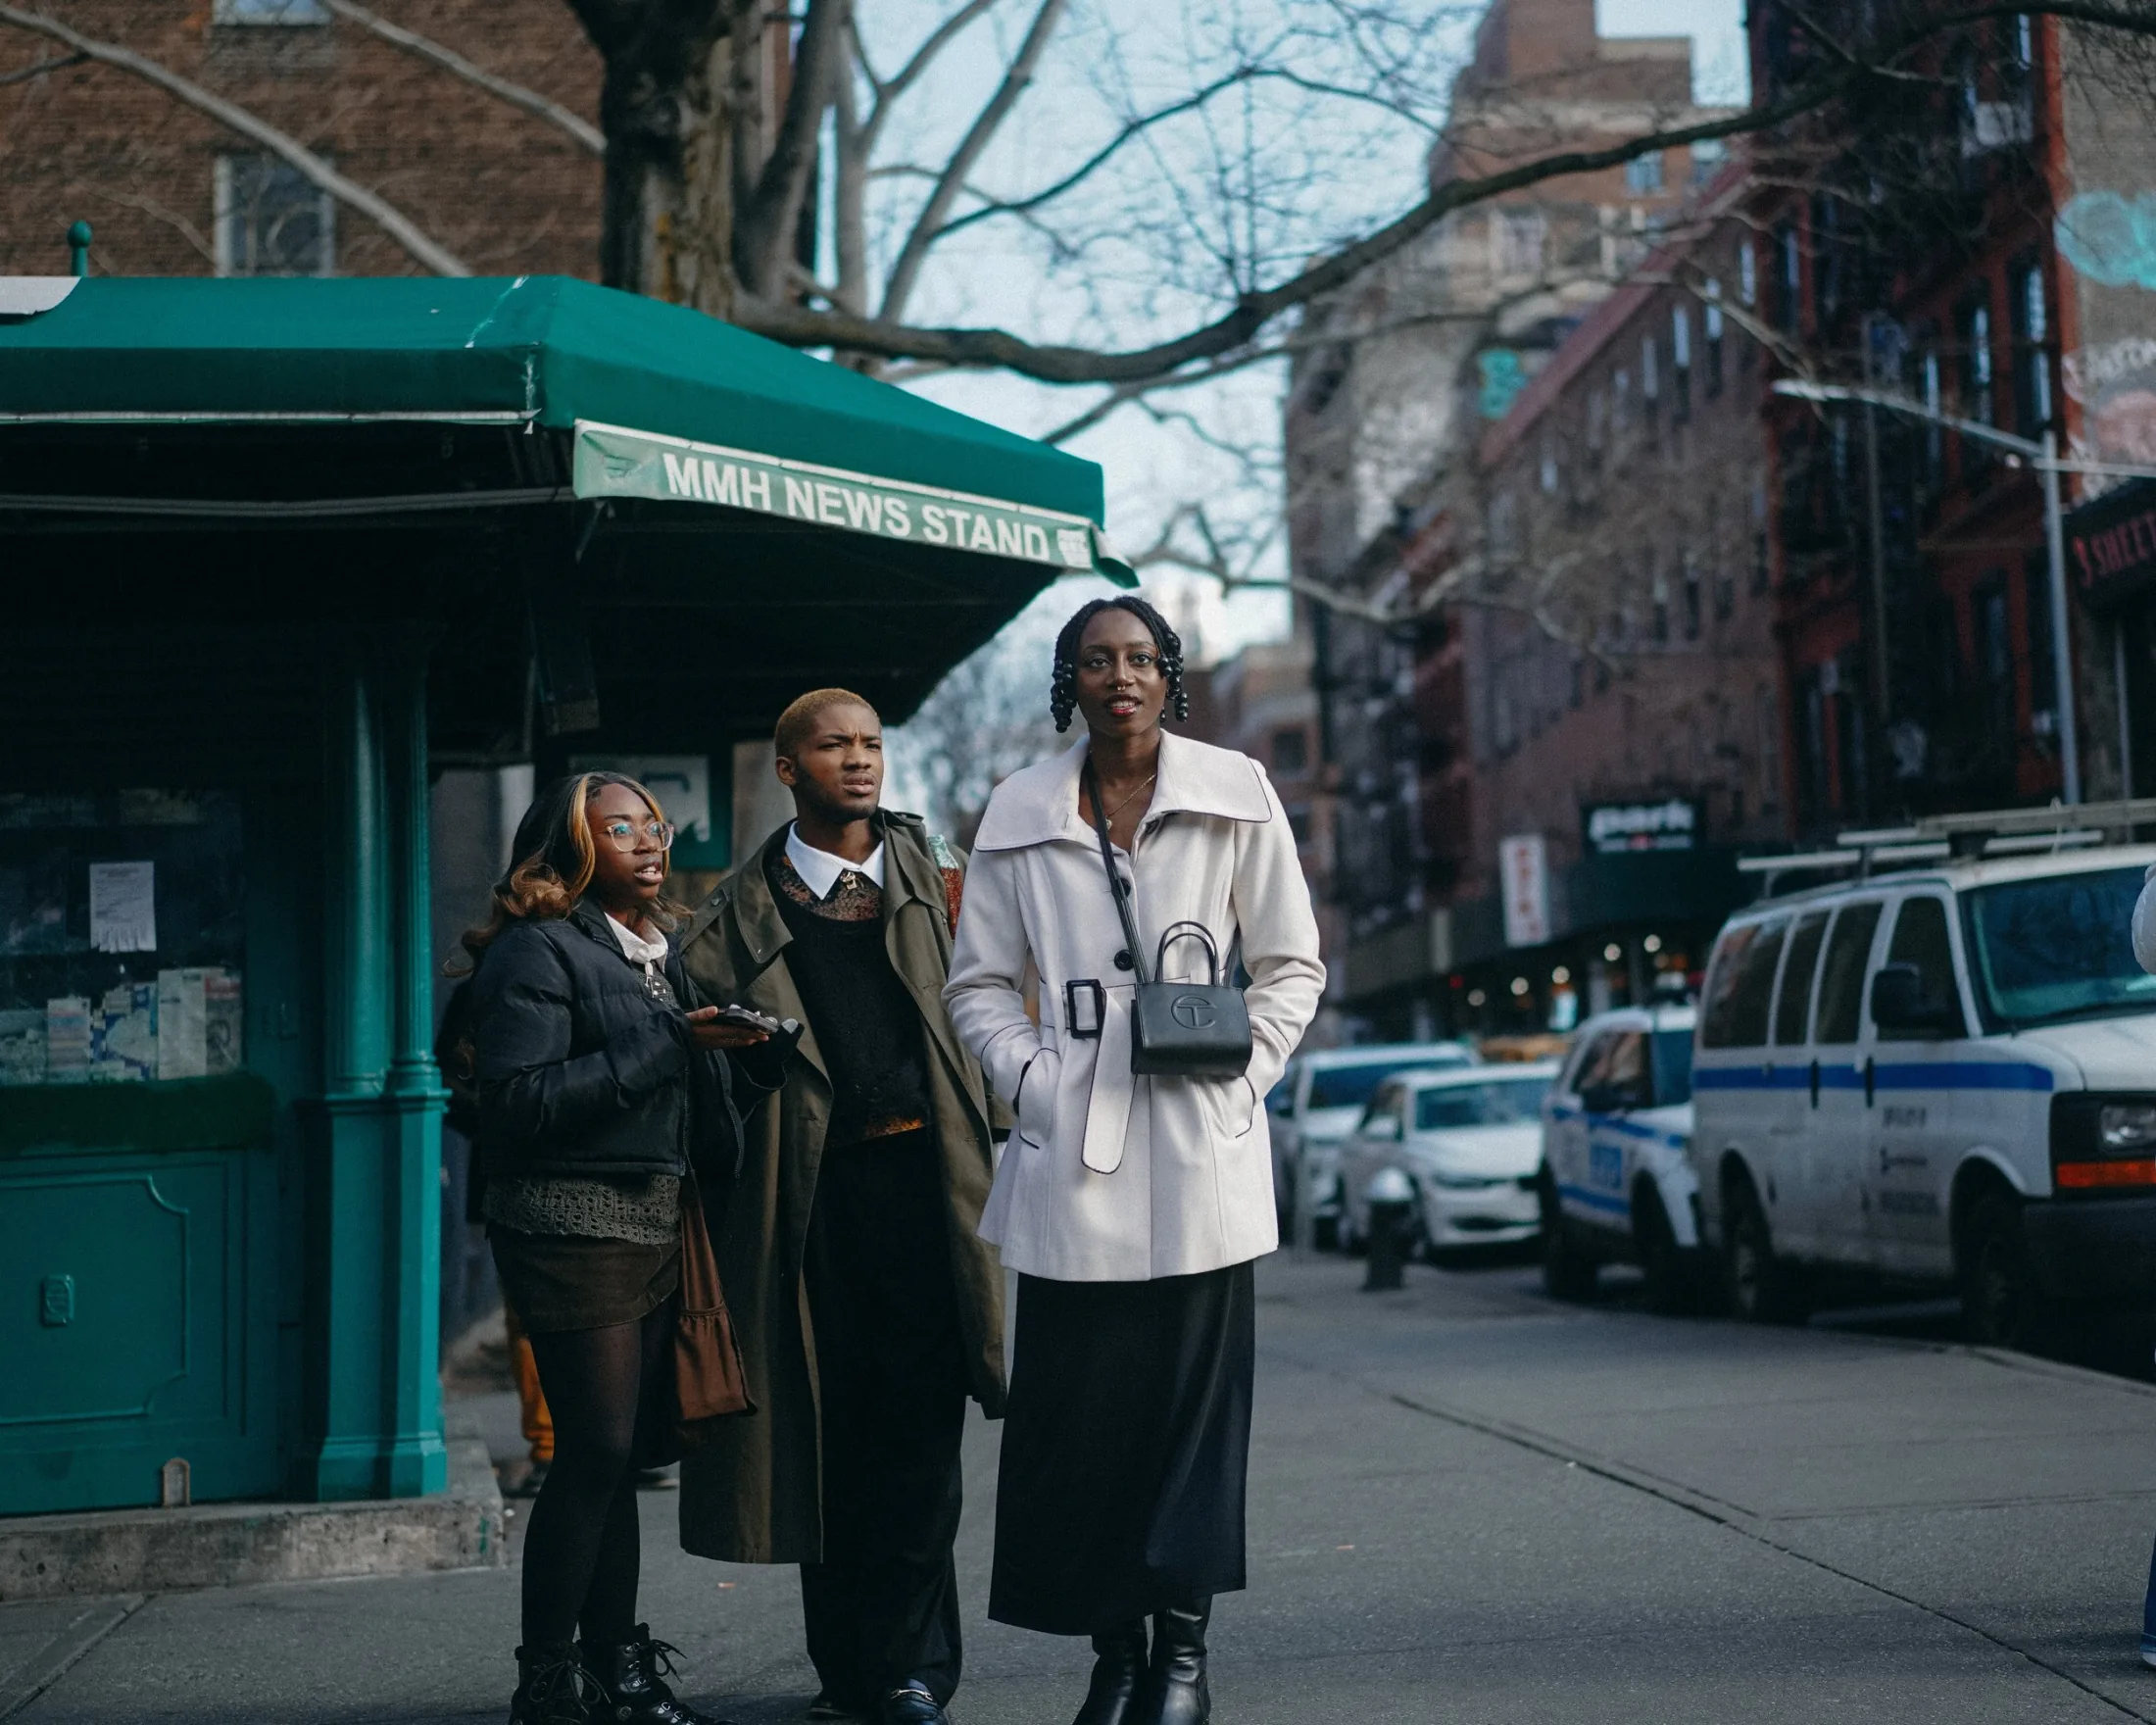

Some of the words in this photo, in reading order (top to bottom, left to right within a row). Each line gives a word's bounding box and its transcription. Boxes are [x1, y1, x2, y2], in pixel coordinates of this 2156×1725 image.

[662, 452, 772, 511] MMH
[785, 475, 911, 537] NEWS
[921, 504, 1051, 562] STAND
